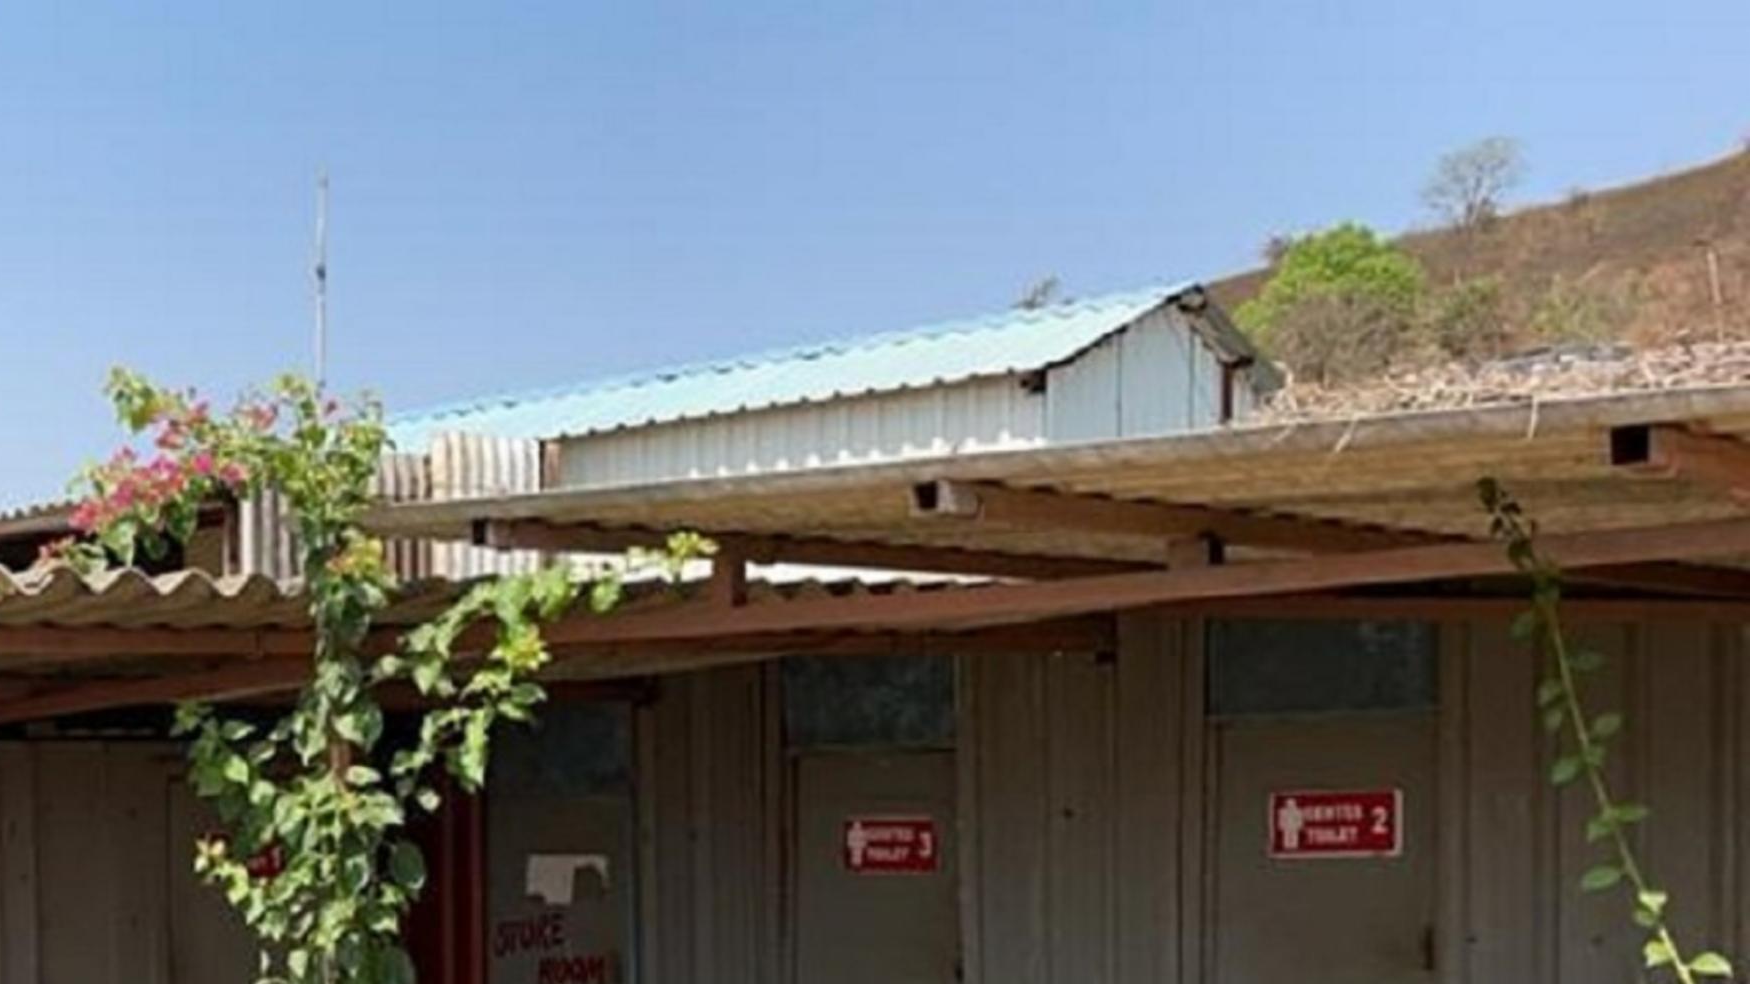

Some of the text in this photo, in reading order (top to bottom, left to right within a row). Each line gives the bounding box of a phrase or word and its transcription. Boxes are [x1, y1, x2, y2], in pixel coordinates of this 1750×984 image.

[1371, 807, 1388, 834] 2
[919, 832, 931, 856] 3
[1306, 827, 1357, 844] TOILET
[867, 847, 909, 861] TOILET
[496, 912, 566, 957] STORE
